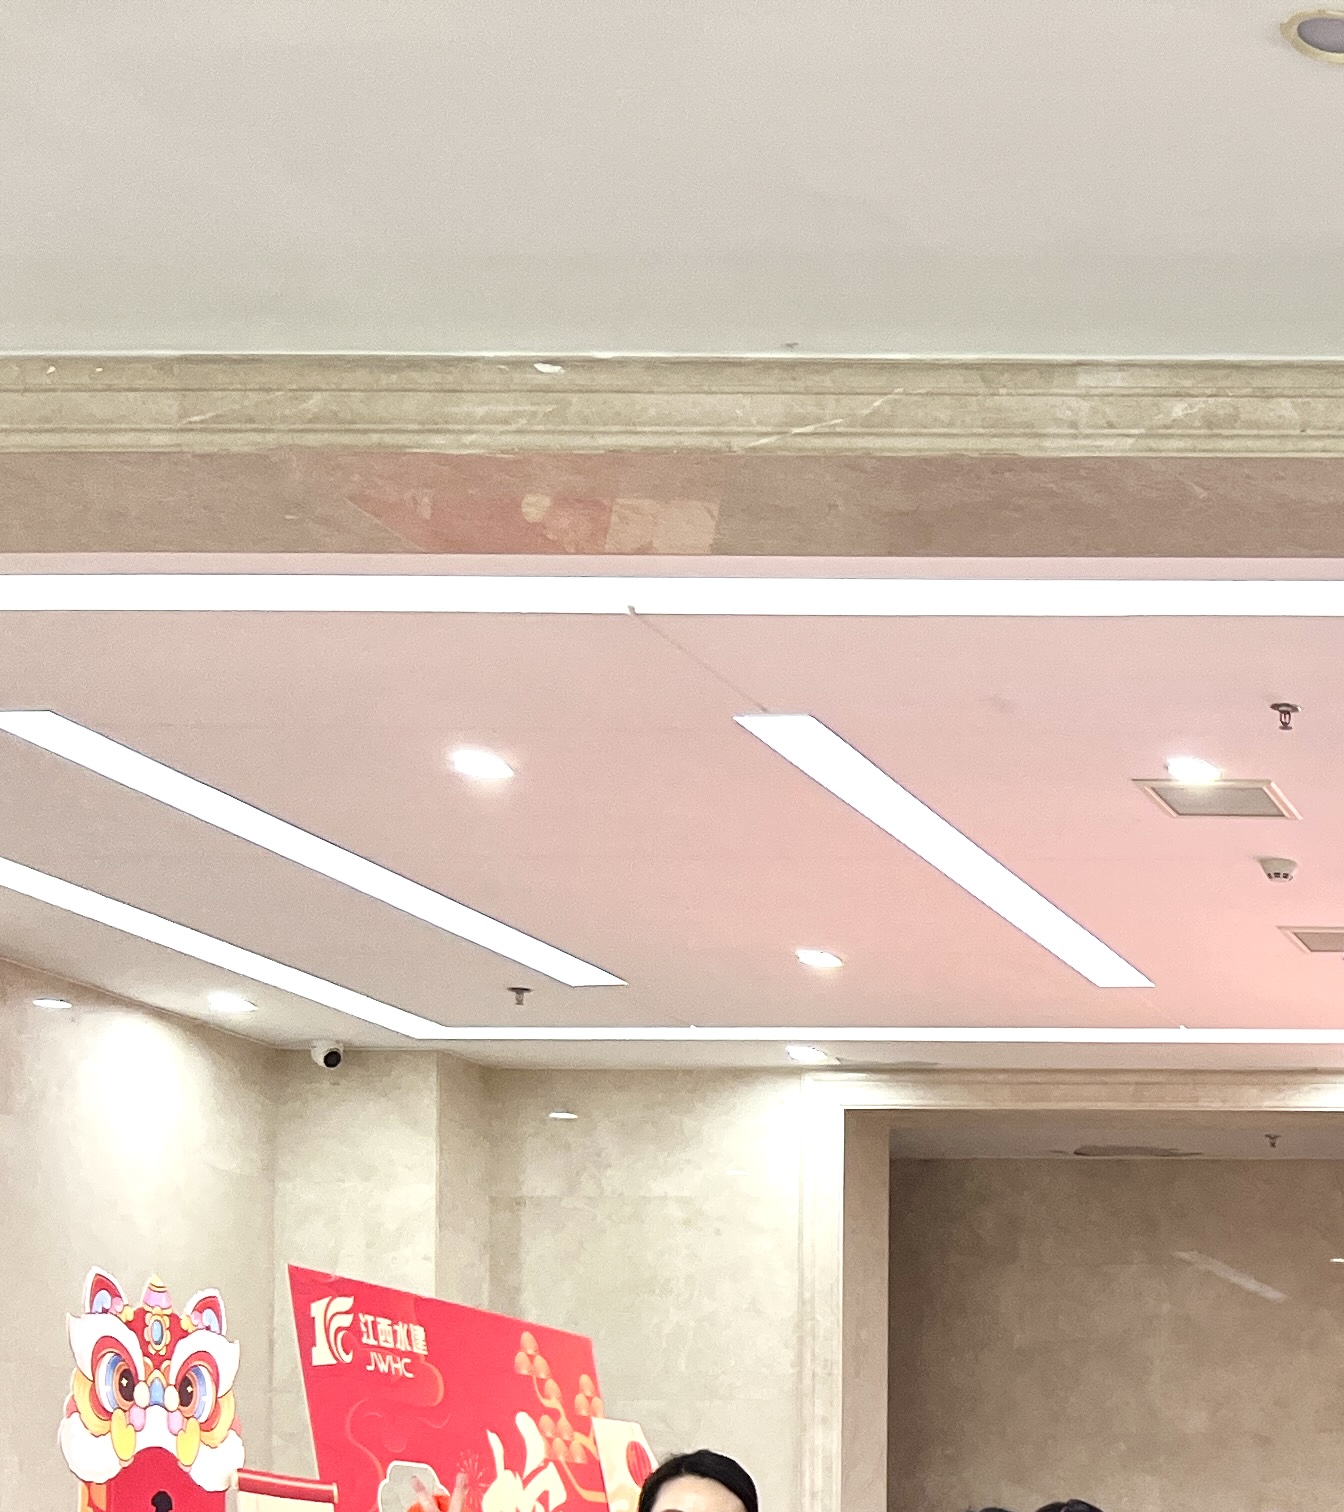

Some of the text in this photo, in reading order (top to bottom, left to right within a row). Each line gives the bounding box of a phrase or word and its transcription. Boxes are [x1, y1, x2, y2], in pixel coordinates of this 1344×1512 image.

[358, 1312, 428, 1355] 江西水建
[366, 1351, 414, 1378] JWHC
